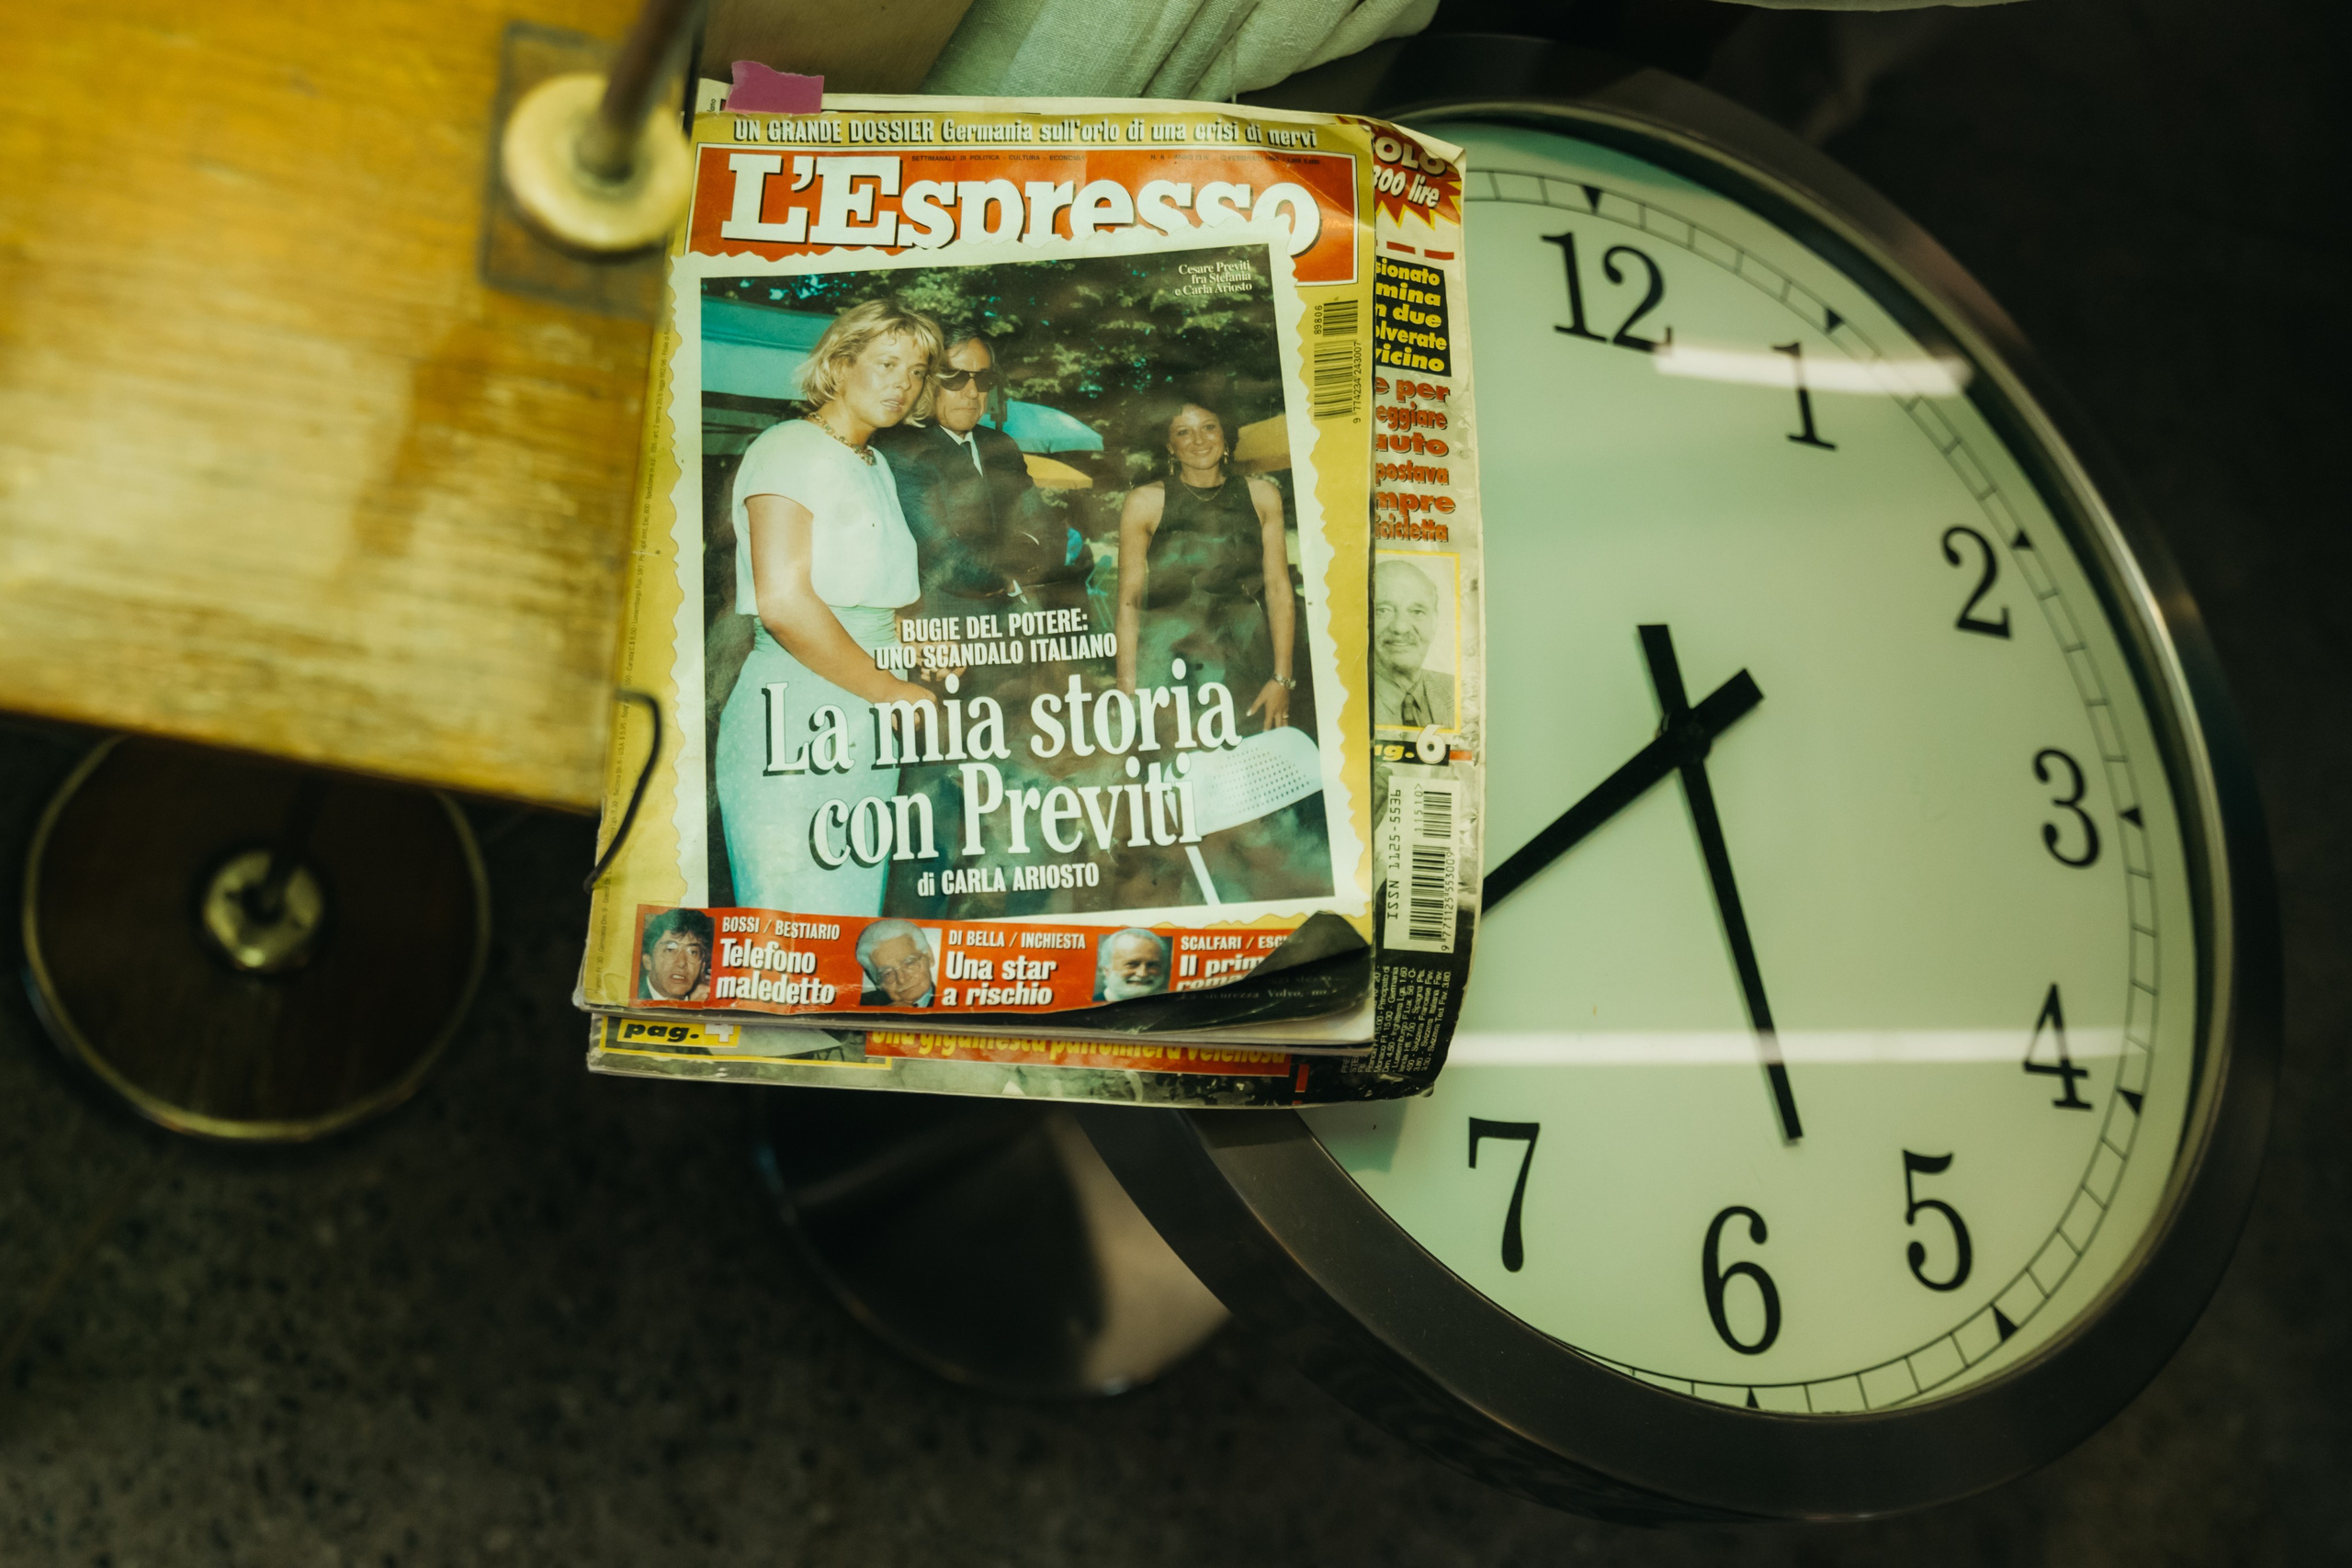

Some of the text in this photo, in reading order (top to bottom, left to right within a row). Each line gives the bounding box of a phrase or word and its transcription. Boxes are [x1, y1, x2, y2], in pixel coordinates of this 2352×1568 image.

[734, 118, 1317, 148] UN GRANDE DOSSIER Germania sull'orlo di una crisi di nervi
[1374, 137, 1447, 177] OLO
[720, 152, 1321, 258] L'Espresso
[1407, 174, 1440, 209] lire
[1178, 260, 1250, 275] Cesare Previti
[1191, 271, 1251, 284] fra Stefania
[1182, 284, 1213, 295] Carla
[1215, 282, 1252, 293] Ariosto
[1540, 231, 1674, 357] 12
[1314, 305, 1323, 335] 89806
[1392, 303, 1442, 328] due
[1352, 341, 1363, 375] 243007
[1353, 378, 1363, 412] 774234
[1396, 379, 1451, 403] per
[1770, 341, 1838, 452] 1
[1939, 524, 2013, 641] 2
[901, 608, 1089, 643] BUGIE DEL POTERE:
[876, 633, 1118, 671] UNO SCANDALO ITALIANO
[763, 658, 1243, 775] La mia storia
[1416, 724, 1447, 764] 6
[808, 751, 1203, 870] con Previti
[2031, 748, 2104, 869] 3
[1387, 789, 1402, 920] ISSN 1125-5536
[917, 862, 1100, 897] di CARLA ARIOSTO
[1445, 852, 1455, 893] 553009
[722, 916, 840, 941] BOSSI BESTIARIO
[1443, 897, 1453, 938] 771125
[720, 938, 817, 975] Telefono
[948, 930, 1086, 950] DI BELLA INCHIESTA
[1181, 935, 1288, 951] SCALFARI ESC
[945, 951, 1057, 981] Una star
[1179, 953, 1267, 978] Il prim
[716, 970, 836, 1006] maledetto
[941, 981, 1054, 1007] a rischio
[624, 1023, 699, 1043] pag.
[2022, 983, 2095, 1112] 4
[1467, 1115, 1541, 1274] 7
[1901, 1147, 1973, 1292] 5
[1701, 1204, 1782, 1356] 6
